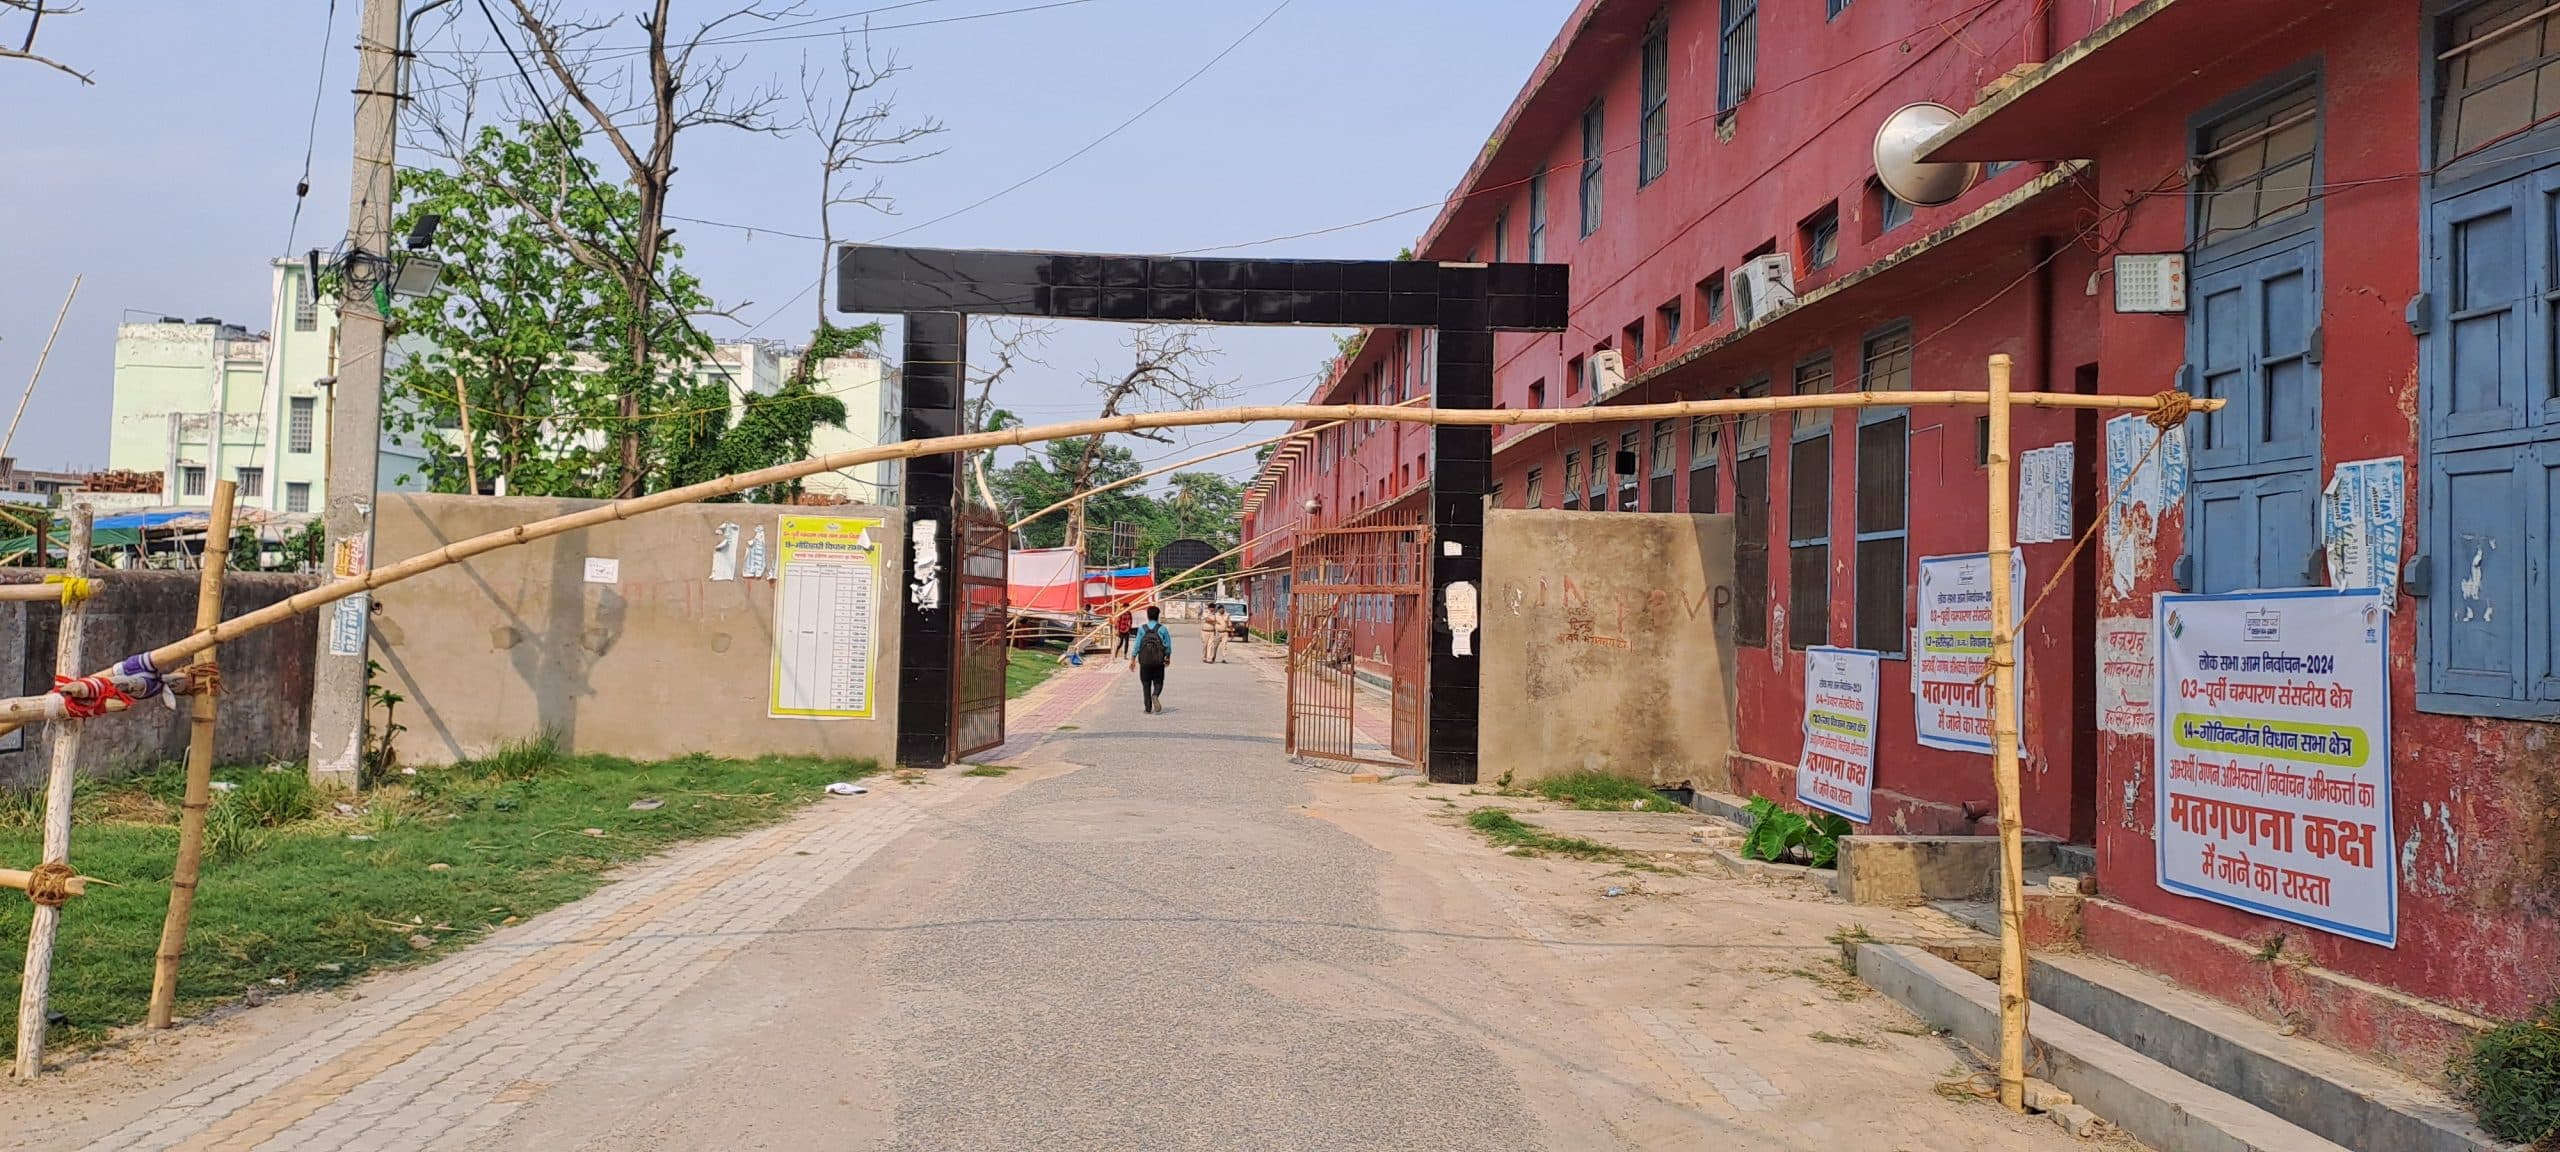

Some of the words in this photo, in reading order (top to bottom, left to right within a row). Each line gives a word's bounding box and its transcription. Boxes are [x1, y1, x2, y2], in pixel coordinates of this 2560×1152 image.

[2380, 498, 2392, 520] IAS
[2199, 651, 2218, 671] लोक
[2220, 656, 2238, 671] सभा
[2241, 656, 2260, 672] आम
[2263, 651, 2334, 674] निर्वाचन-2024
[2181, 677, 2227, 708] 03-पूर्वी
[2229, 683, 2277, 704] चम्पारण
[2278, 679, 2327, 708] संसदीय
[2330, 682, 2354, 709] क्षेत्र
[2184, 721, 2260, 747] 14-गोविन्दगंज
[2262, 725, 2298, 750] विधान
[2300, 734, 2327, 754] सभा
[2329, 731, 2353, 757] क्षेत्र
[1847, 761, 1868, 787] कक्ष
[2358, 783, 2375, 809] का
[2170, 792, 2295, 853] मतगणना
[2303, 815, 2377, 869] कक्ष
[2218, 850, 2250, 888] जाने
[2254, 863, 2279, 896] का
[2281, 868, 2331, 907] रास्ता
